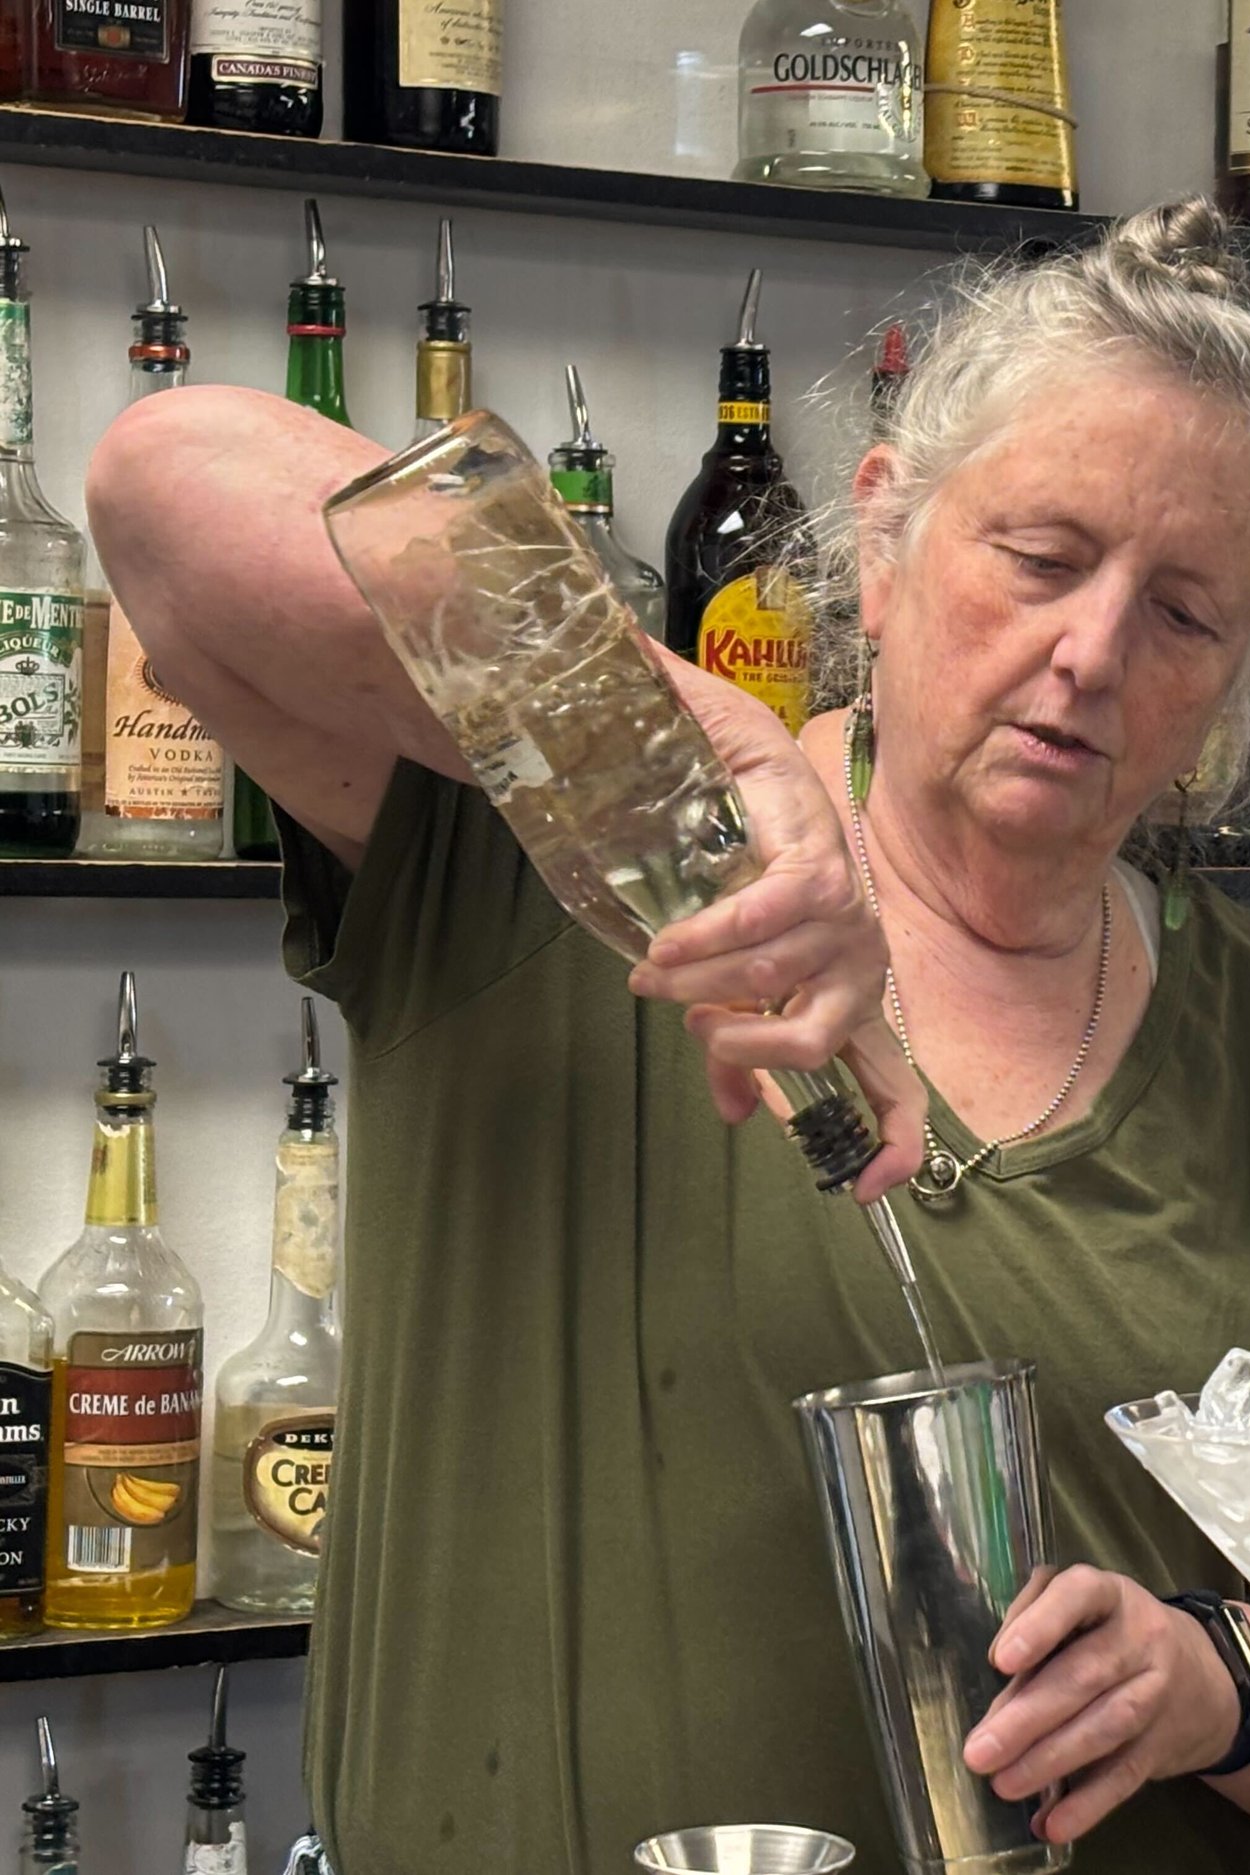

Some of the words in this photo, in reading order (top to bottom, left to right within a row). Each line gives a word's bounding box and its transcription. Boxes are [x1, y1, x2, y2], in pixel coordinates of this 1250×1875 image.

[66, 0, 110, 16] SINGLE
[114, 3, 161, 23] BARREL
[219, 62, 281, 77] CANADA'S
[15, 604, 31, 620] DE
[113, 709, 214, 741] Handm
[149, 747, 214, 762] VODKA
[129, 787, 173, 797] AUSTIN
[101, 1342, 186, 1361] ARROW
[69, 1392, 130, 1416] CREME
[134, 1394, 157, 1415] de
[0, 1423, 41, 1443] ms
[284, 1433, 334, 1444] DEK
